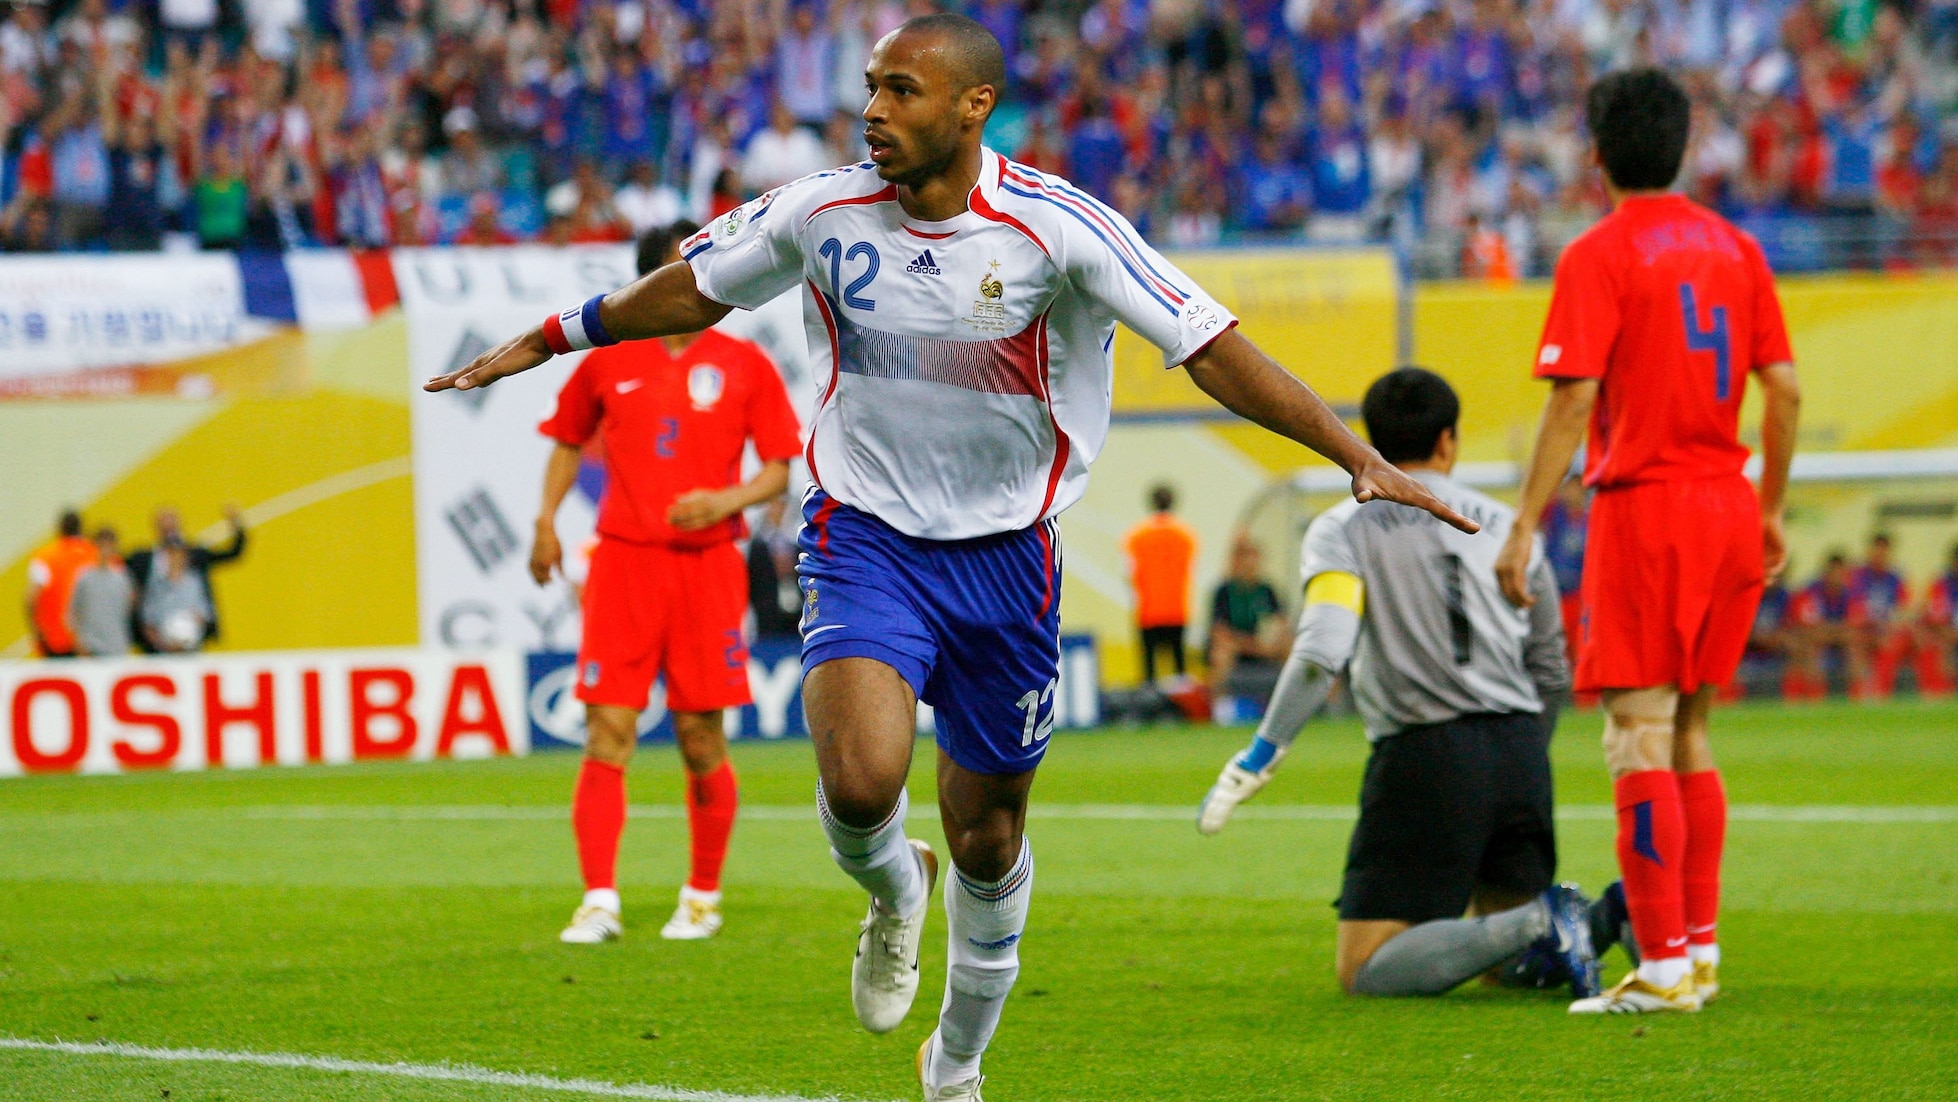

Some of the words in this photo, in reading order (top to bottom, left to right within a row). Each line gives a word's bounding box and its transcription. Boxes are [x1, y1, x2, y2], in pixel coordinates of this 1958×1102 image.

[818, 237, 881, 312] 12
[906, 264, 942, 276] adidas
[1679, 282, 1729, 399] 4
[655, 418, 679, 458] 2
[1435, 552, 1471, 666] 1
[724, 630, 747, 668] 2
[11, 665, 513, 774] OSHIBA
[1016, 678, 1057, 748] 12
